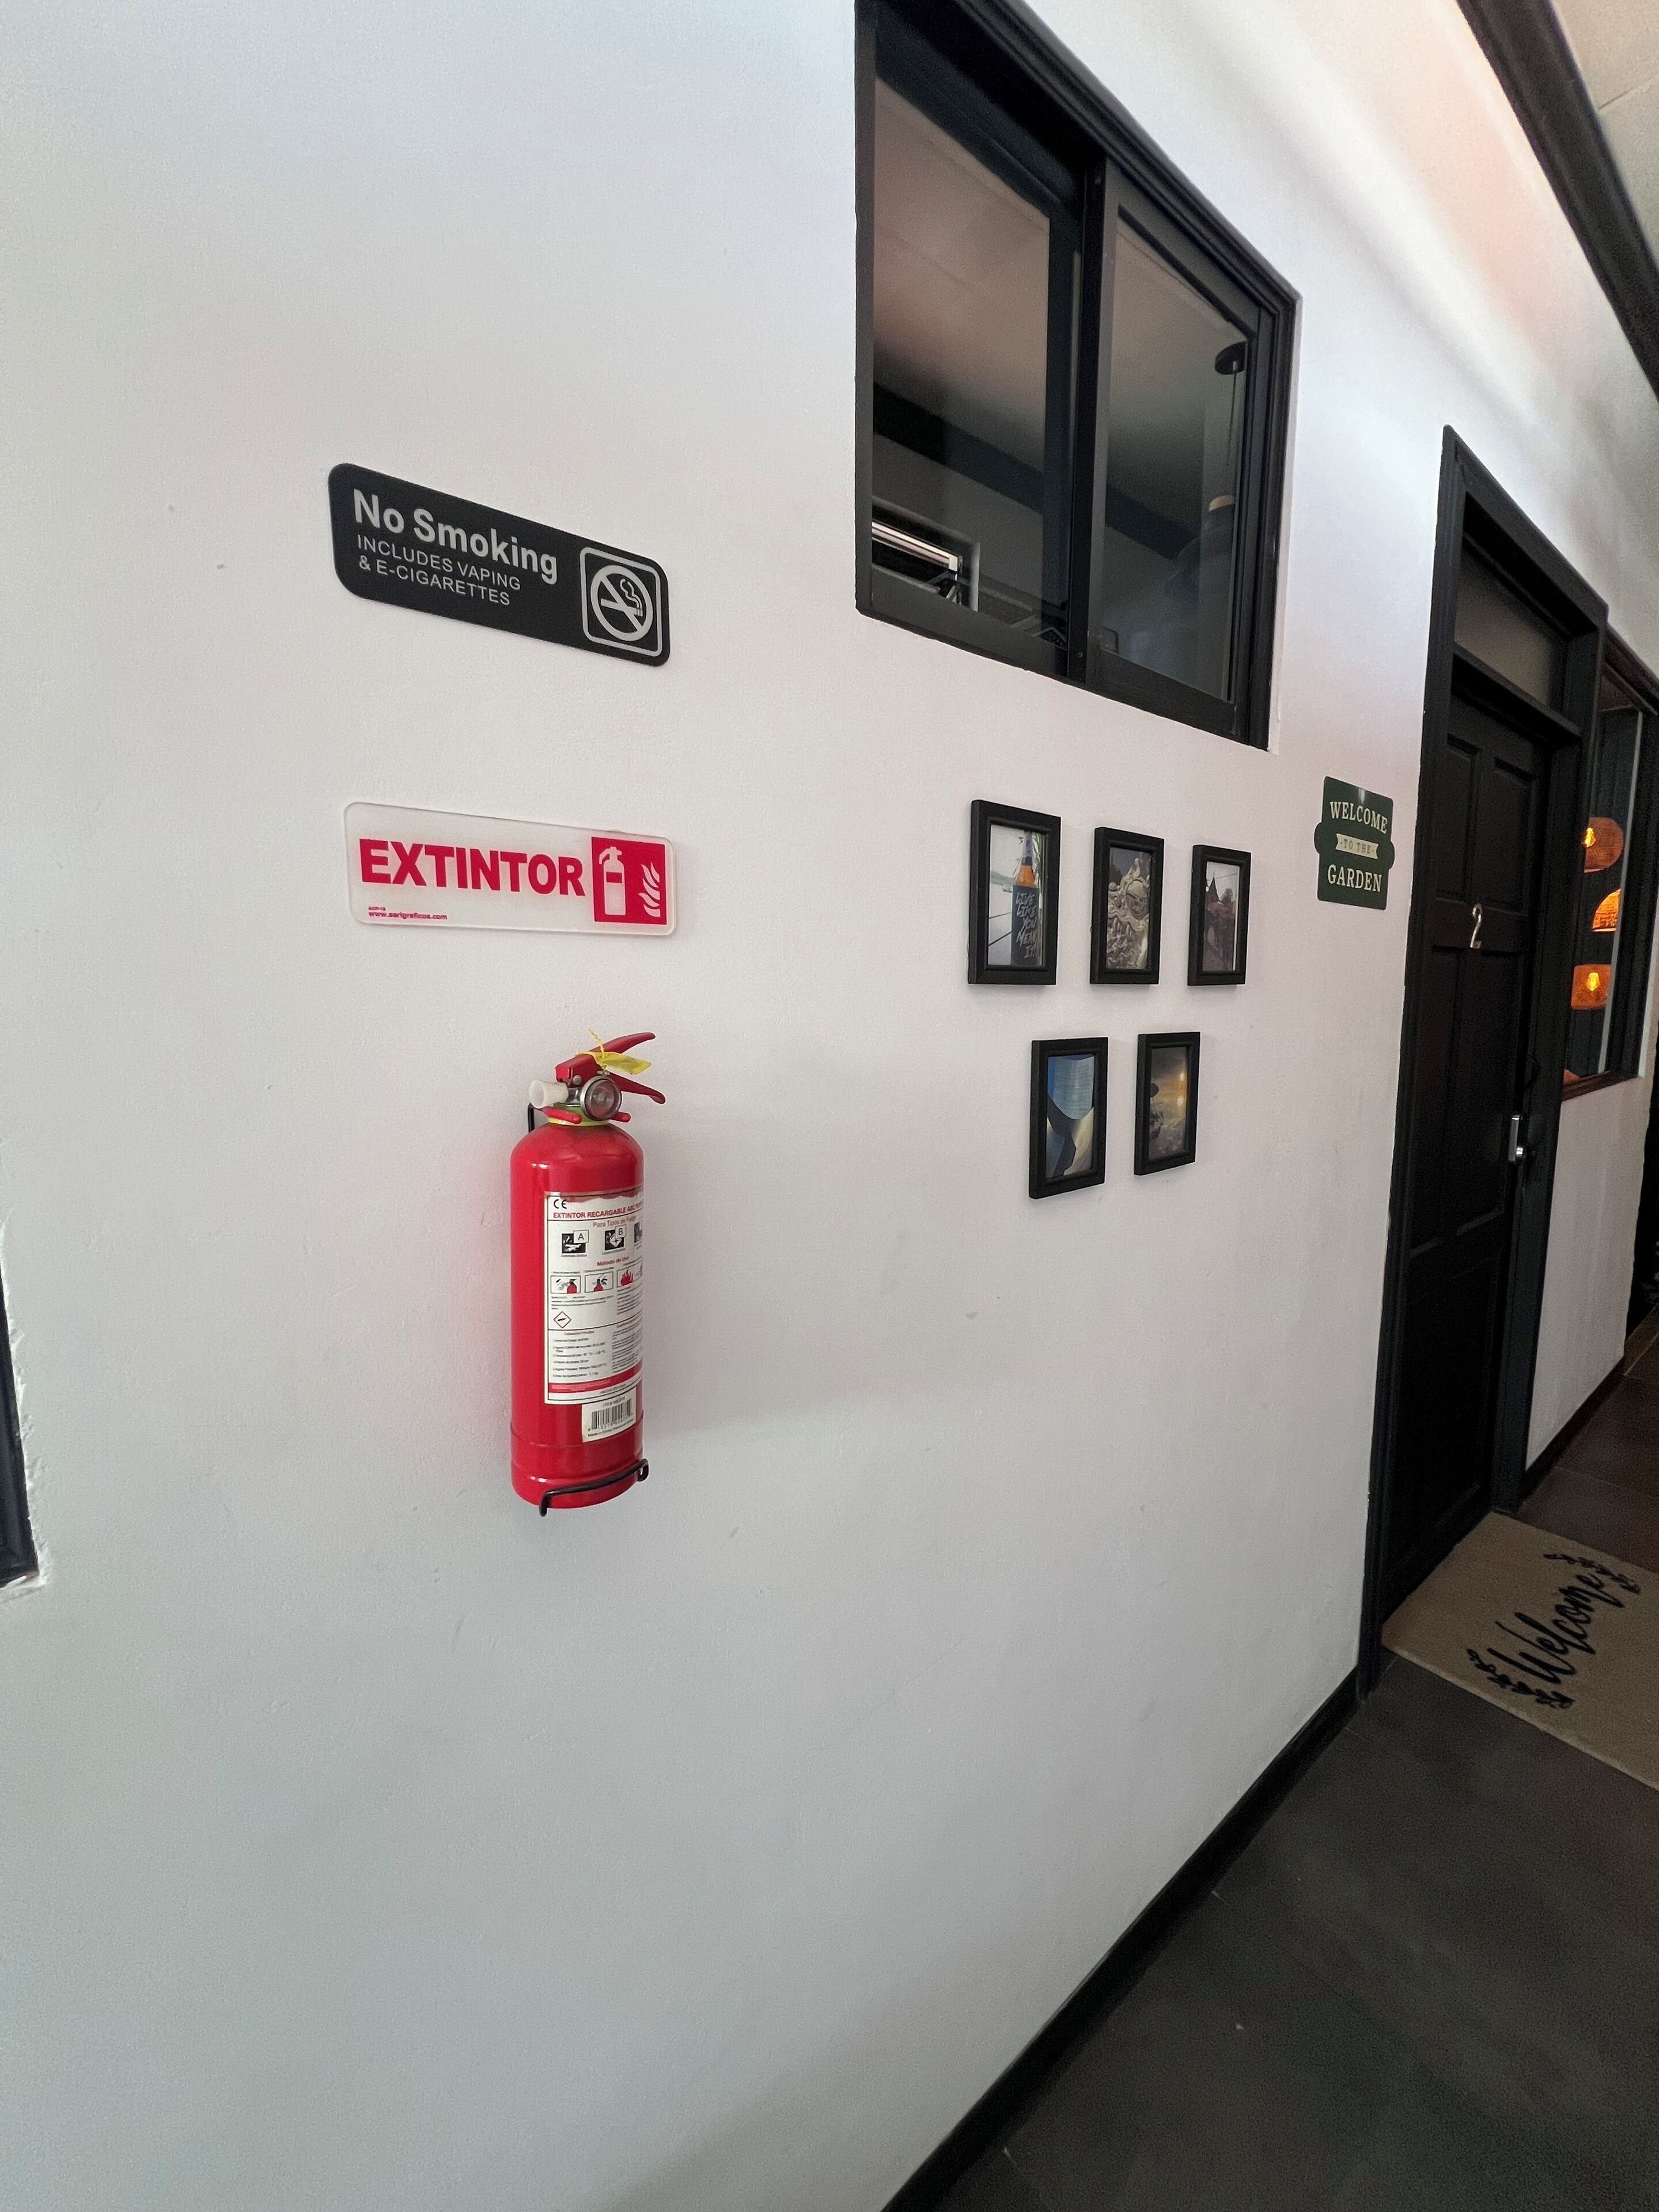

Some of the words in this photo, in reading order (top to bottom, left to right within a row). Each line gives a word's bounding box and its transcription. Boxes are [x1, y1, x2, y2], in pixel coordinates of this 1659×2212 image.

[353, 488, 405, 533] No
[414, 508, 559, 585] Smoking
[357, 534, 453, 573] INCLUDES
[457, 562, 521, 590] VAPING
[358, 555, 371, 571] &
[377, 559, 510, 605] E-CIGARETTES
[1330, 801, 1388, 834] WELCOME
[1344, 839, 1353, 850] TO
[1357, 842, 1372, 854] THE
[359, 838, 586, 896] EXTINTOR
[1327, 864, 1382, 892] GARDEN
[1016, 892, 1035, 906] LIVE
[1017, 904, 1037, 917] LIKE
[1019, 916, 1037, 933] YOU
[1470, 903, 1483, 949] 2
[587, 1207, 626, 1218] RECARGABLE
[1486, 1572, 1626, 1685] Welcome
